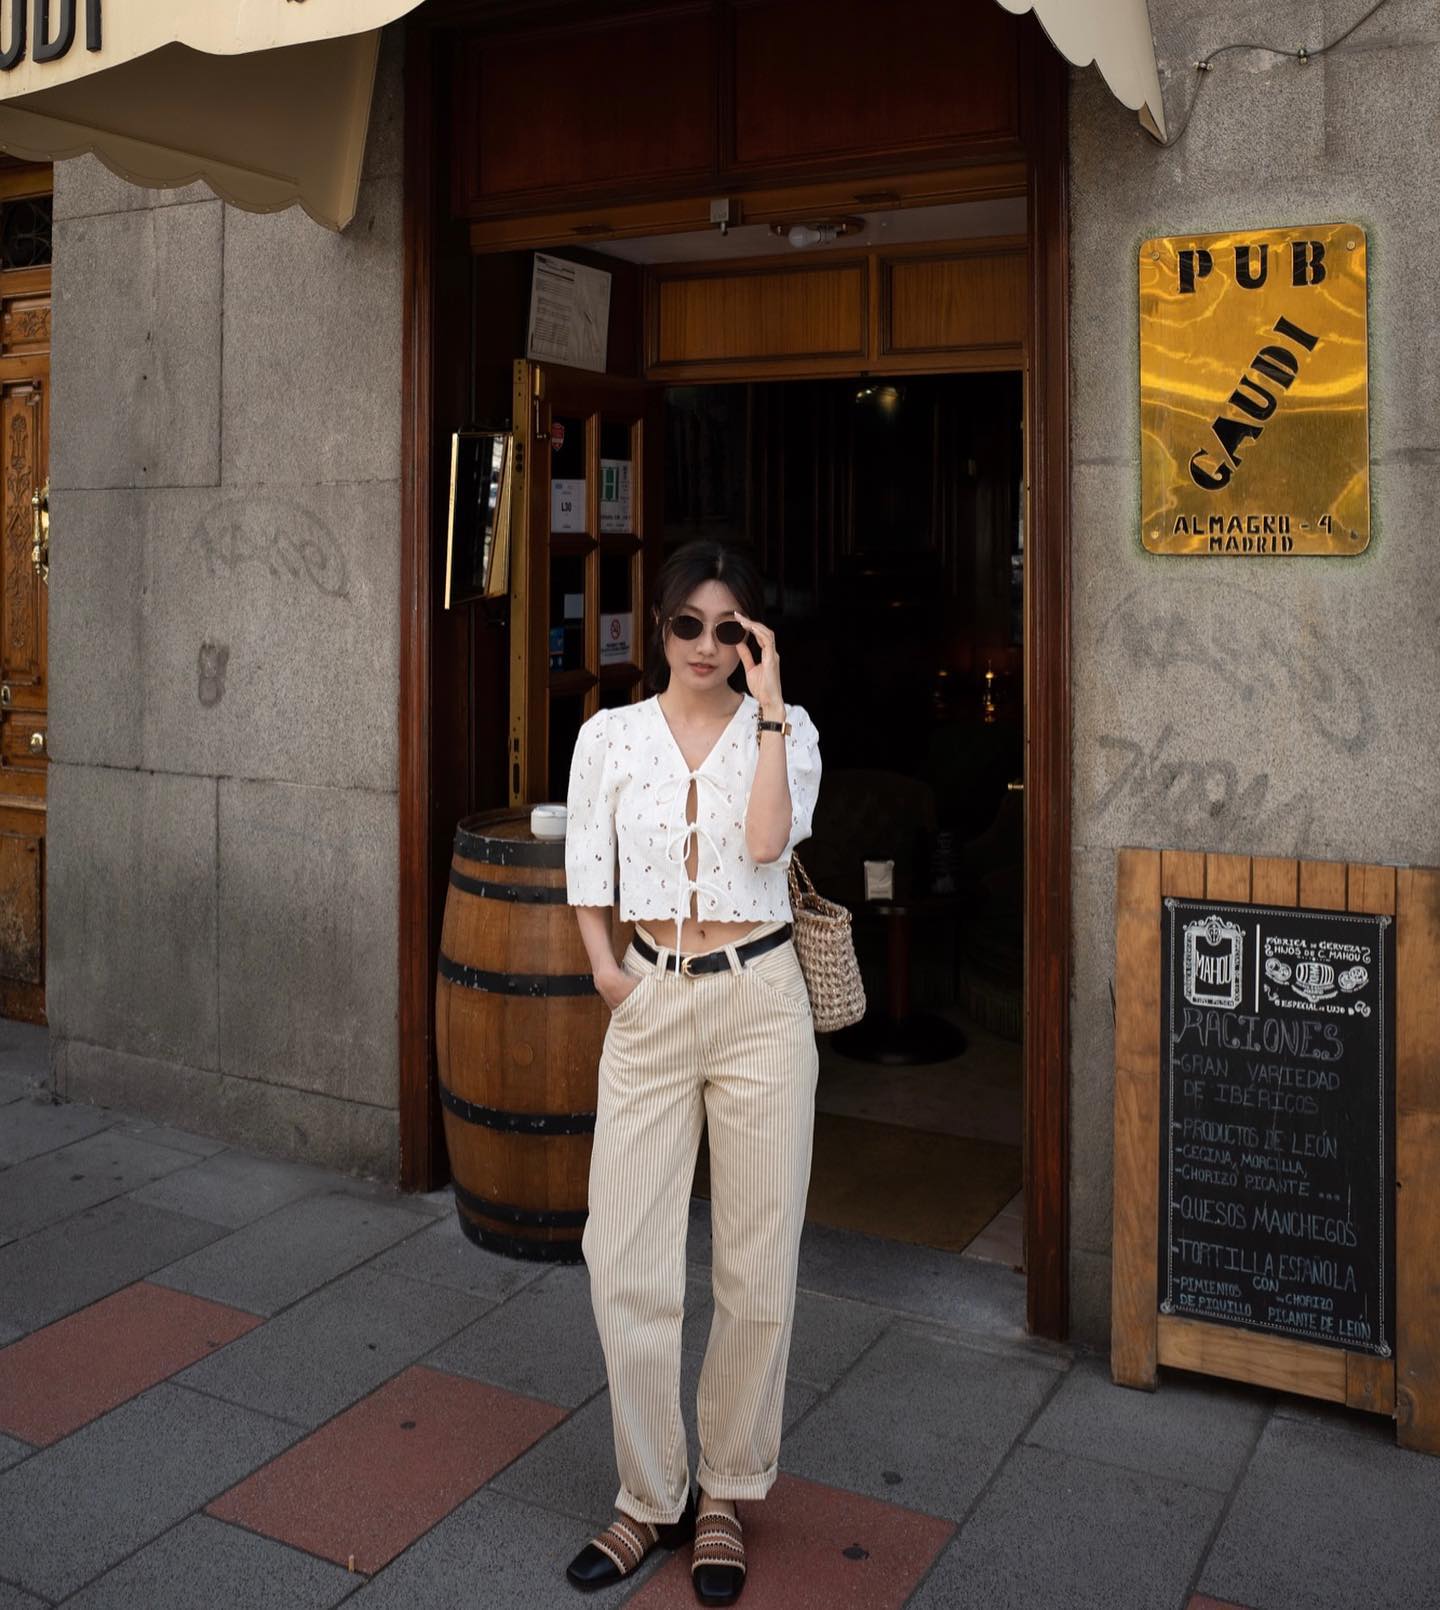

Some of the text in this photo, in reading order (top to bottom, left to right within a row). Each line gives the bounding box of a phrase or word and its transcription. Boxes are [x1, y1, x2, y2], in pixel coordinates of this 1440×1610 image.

[1177, 240, 1327, 294] PUB
[1188, 315, 1320, 491] GAUDI
[1173, 515, 1291, 535] ALMAGRO
[1317, 515, 1332, 534] 4
[1209, 535, 1293, 553] MADRID
[1195, 950, 1233, 985] MAHOU
[1274, 946, 1301, 956] HIJOS
[1329, 951, 1361, 961] MAHOU
[1176, 1007, 1344, 1061] RACIONES
[1184, 1079, 1205, 1100] DE
[1247, 1061, 1340, 1091] VARIEDAD
[1264, 1129, 1285, 1151] DE
[1292, 1129, 1337, 1159] LEÓN
[1245, 1174, 1310, 1197] PICANTE
[1252, 1200, 1357, 1247] MANCHEGOS
[1252, 1275, 1279, 1292] CON
[1180, 1293, 1251, 1317] DE PIQUILLO
[1268, 1306, 1371, 1340] PICANTE DE LEÓN
